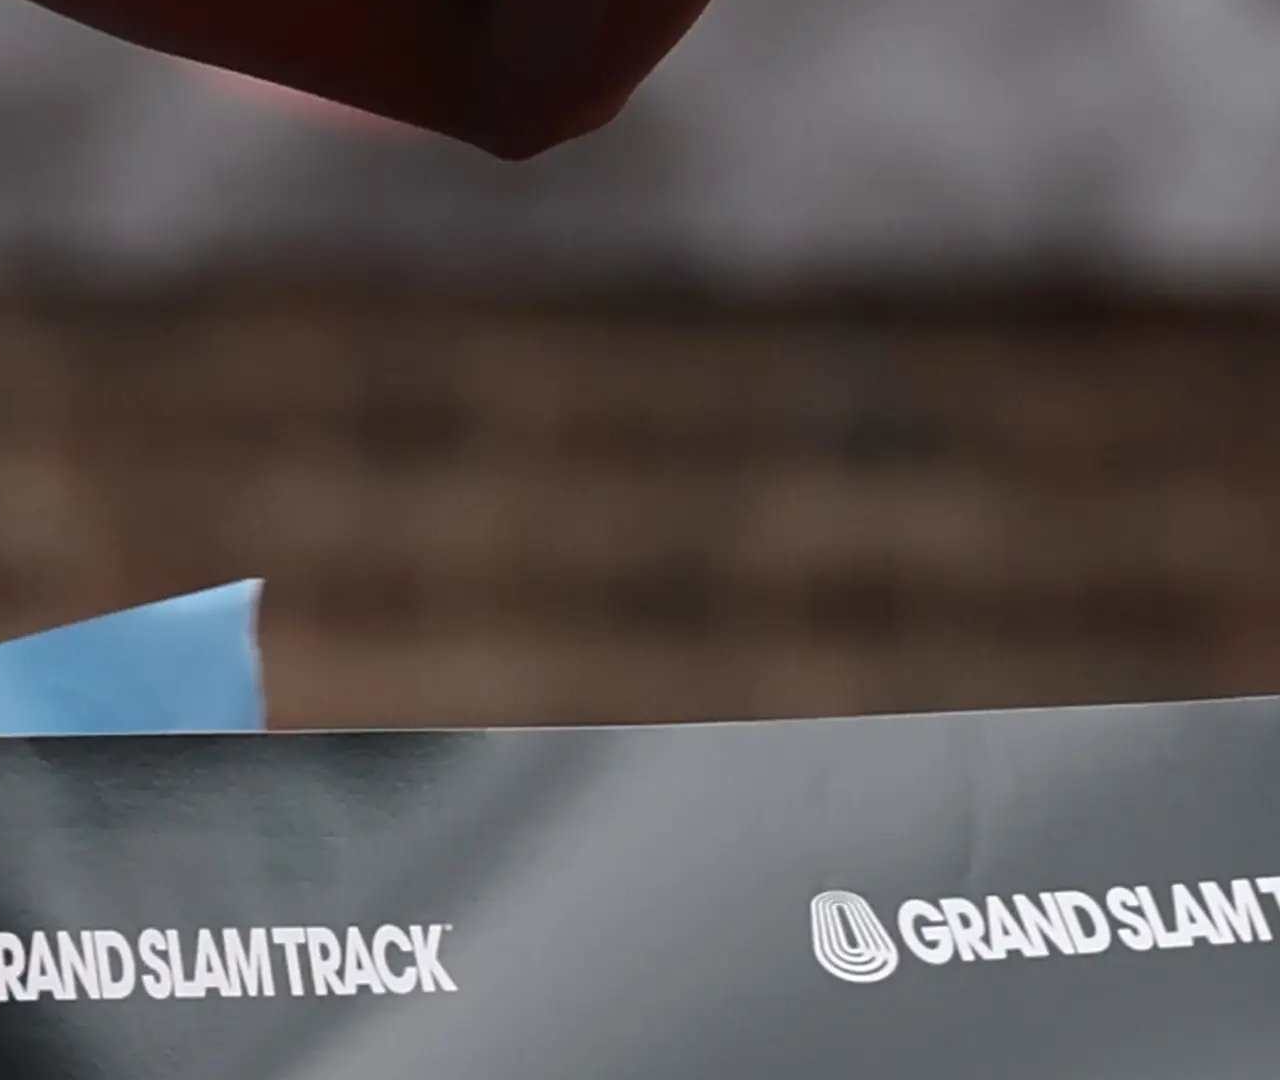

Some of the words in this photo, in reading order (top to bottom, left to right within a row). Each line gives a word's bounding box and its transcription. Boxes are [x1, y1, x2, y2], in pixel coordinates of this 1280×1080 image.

[139, 927, 276, 1000] SLAM
[272, 924, 458, 997] TRACK
[897, 890, 1112, 965] GRAND
[1105, 877, 1274, 951] SLAM
